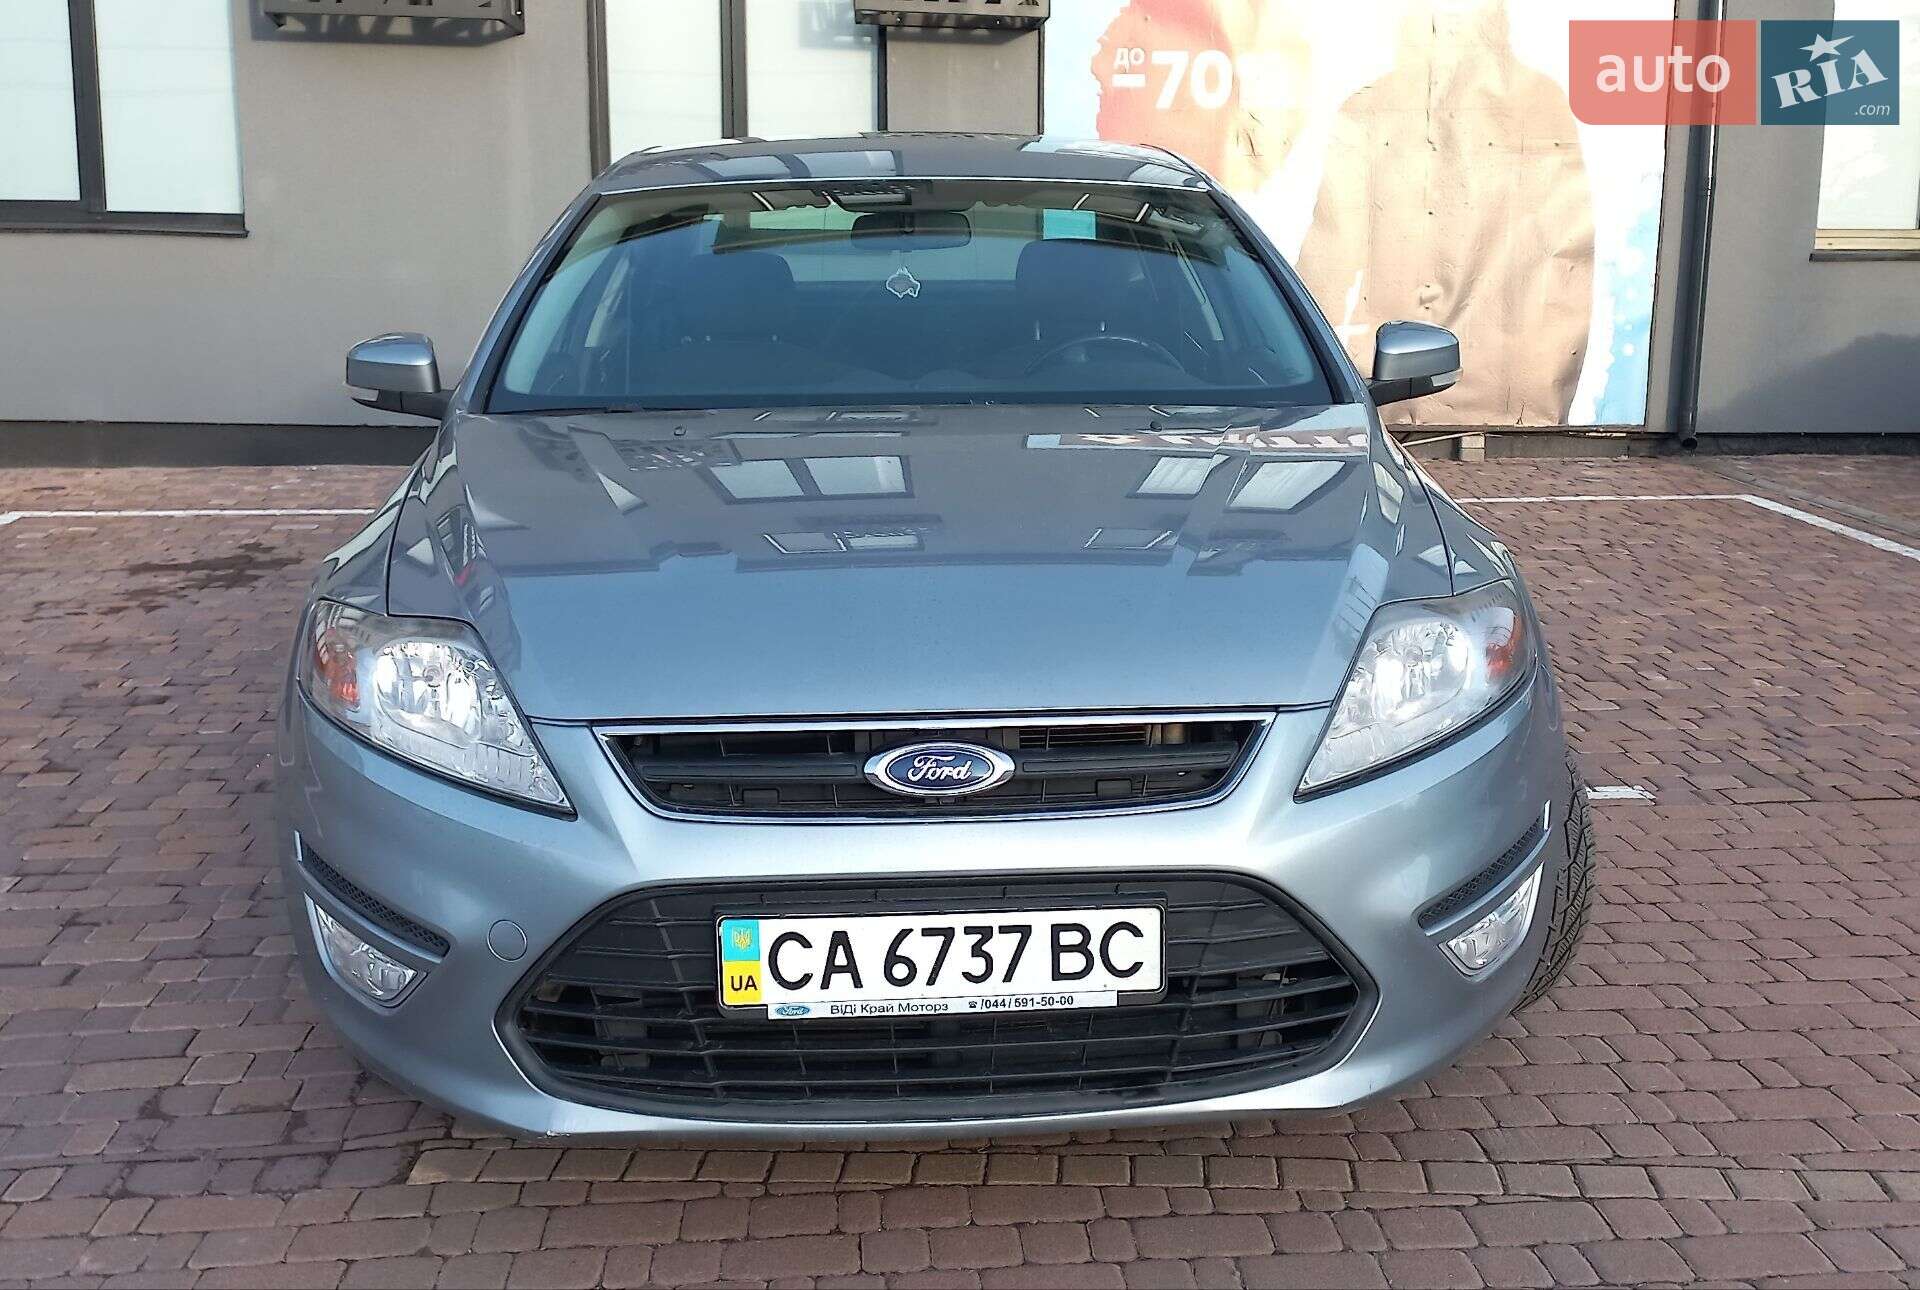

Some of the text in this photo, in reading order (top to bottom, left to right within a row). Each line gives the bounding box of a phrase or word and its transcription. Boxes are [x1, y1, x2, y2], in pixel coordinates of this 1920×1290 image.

[907, 755, 972, 782] Ford
[769, 921, 1144, 990] CA 6737 BC
[731, 975, 758, 993] UA
[860, 1002, 894, 1015] Край
[898, 1001, 949, 1014] Моторз
